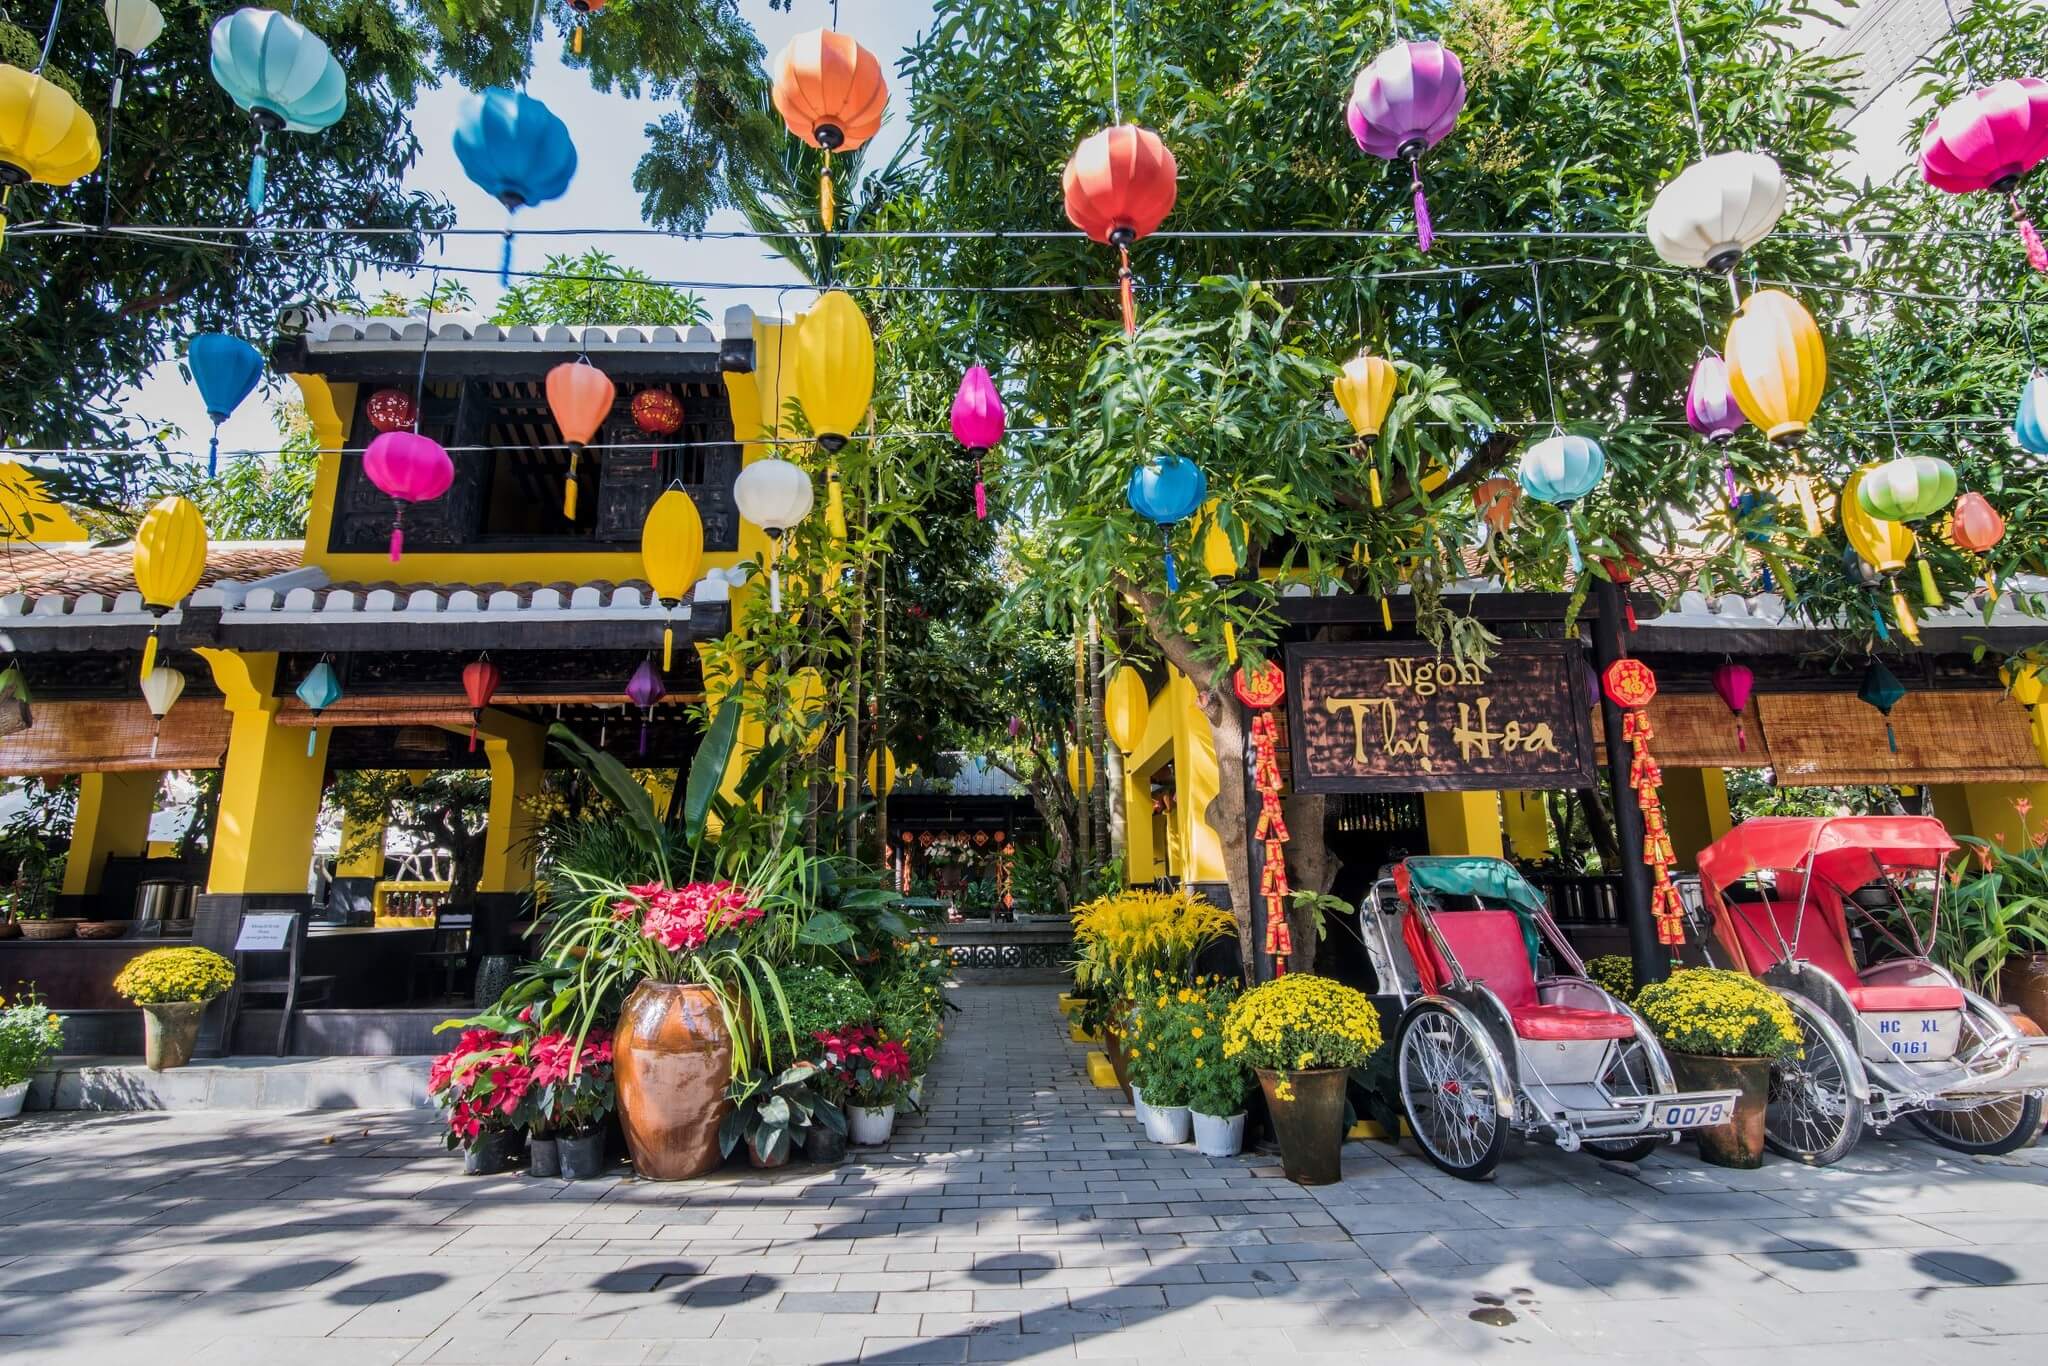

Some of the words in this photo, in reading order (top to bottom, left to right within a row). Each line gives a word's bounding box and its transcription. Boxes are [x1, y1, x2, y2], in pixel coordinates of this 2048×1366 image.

[1384, 657, 1485, 696] Ngon
[1453, 697, 1559, 763] Hoa
[1880, 1020, 1901, 1033] HC
[1922, 1019, 1940, 1032] XL
[1892, 1041, 1928, 1054] 0161
[1666, 1103, 1723, 1125] 0079
